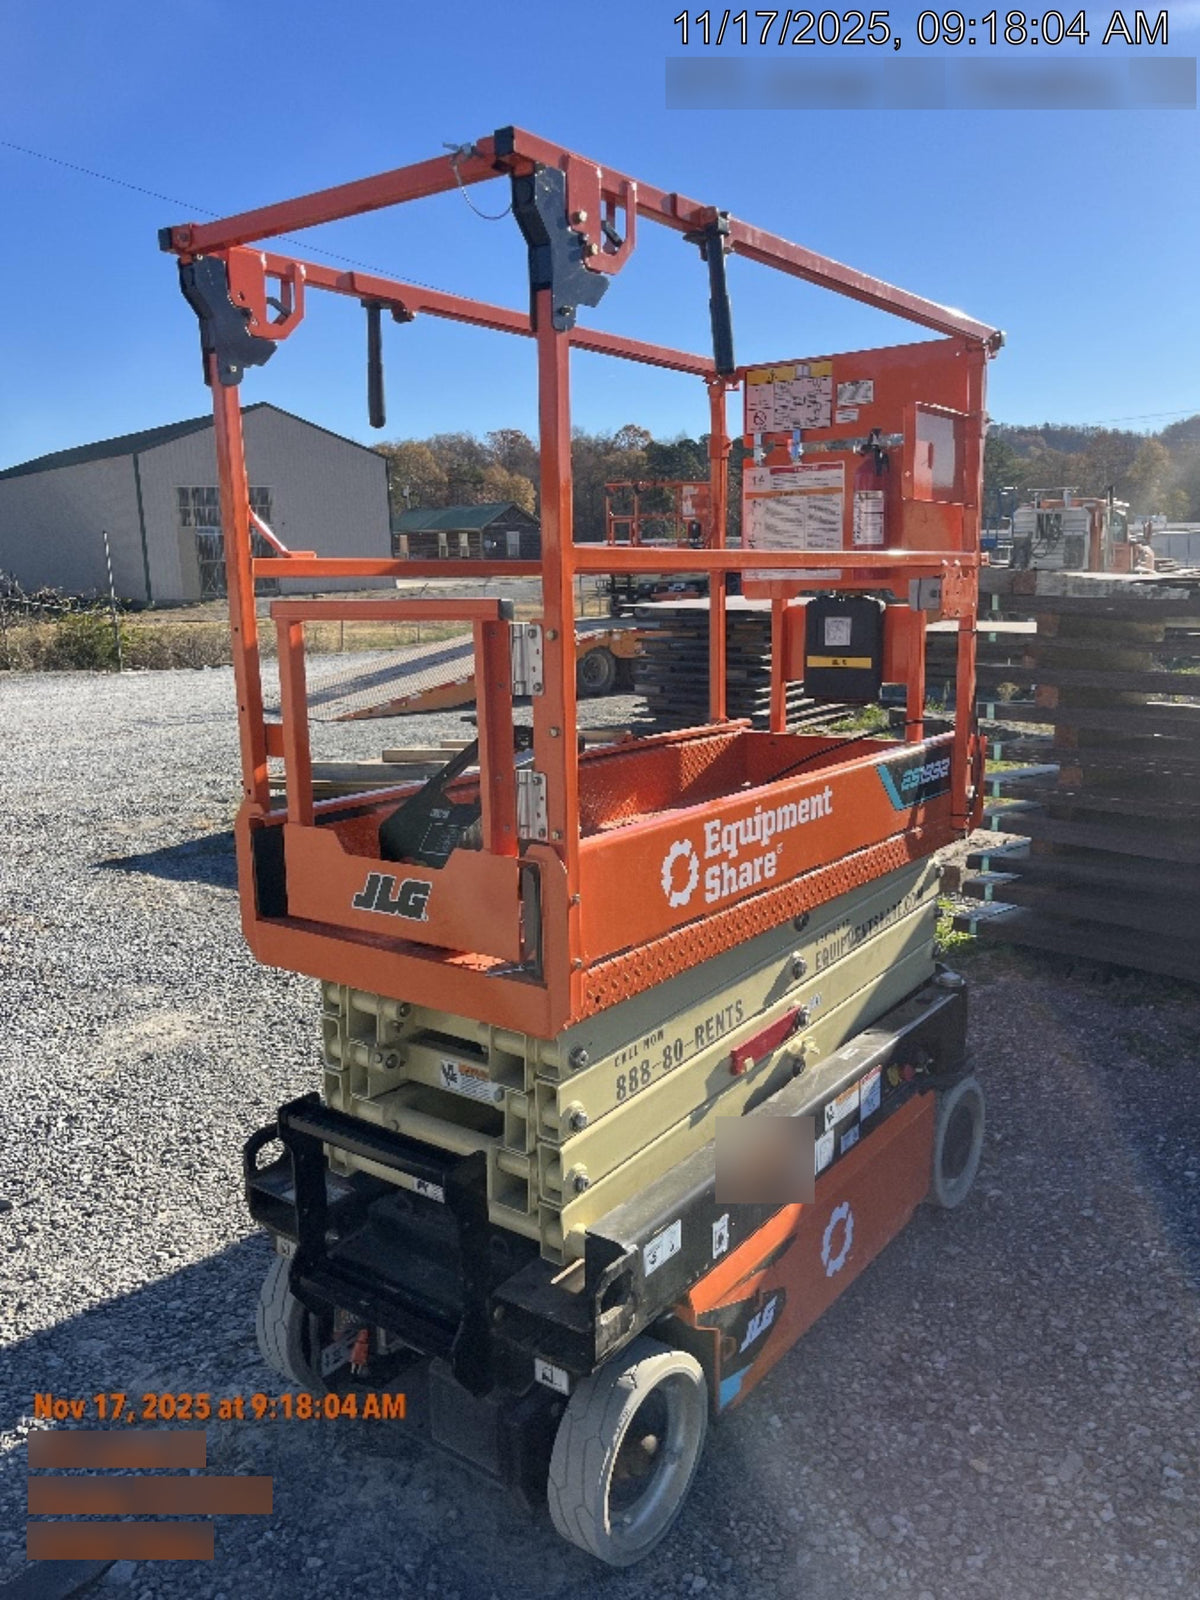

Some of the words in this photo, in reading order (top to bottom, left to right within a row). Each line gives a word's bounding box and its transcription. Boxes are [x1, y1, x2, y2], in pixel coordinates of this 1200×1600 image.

[704, 785, 833, 860] Equipment
[352, 871, 432, 922] JLG
[704, 850, 778, 904] Share
[615, 999, 745, 1101] 888-80-RENTS
[739, 1295, 778, 1354] JLG
